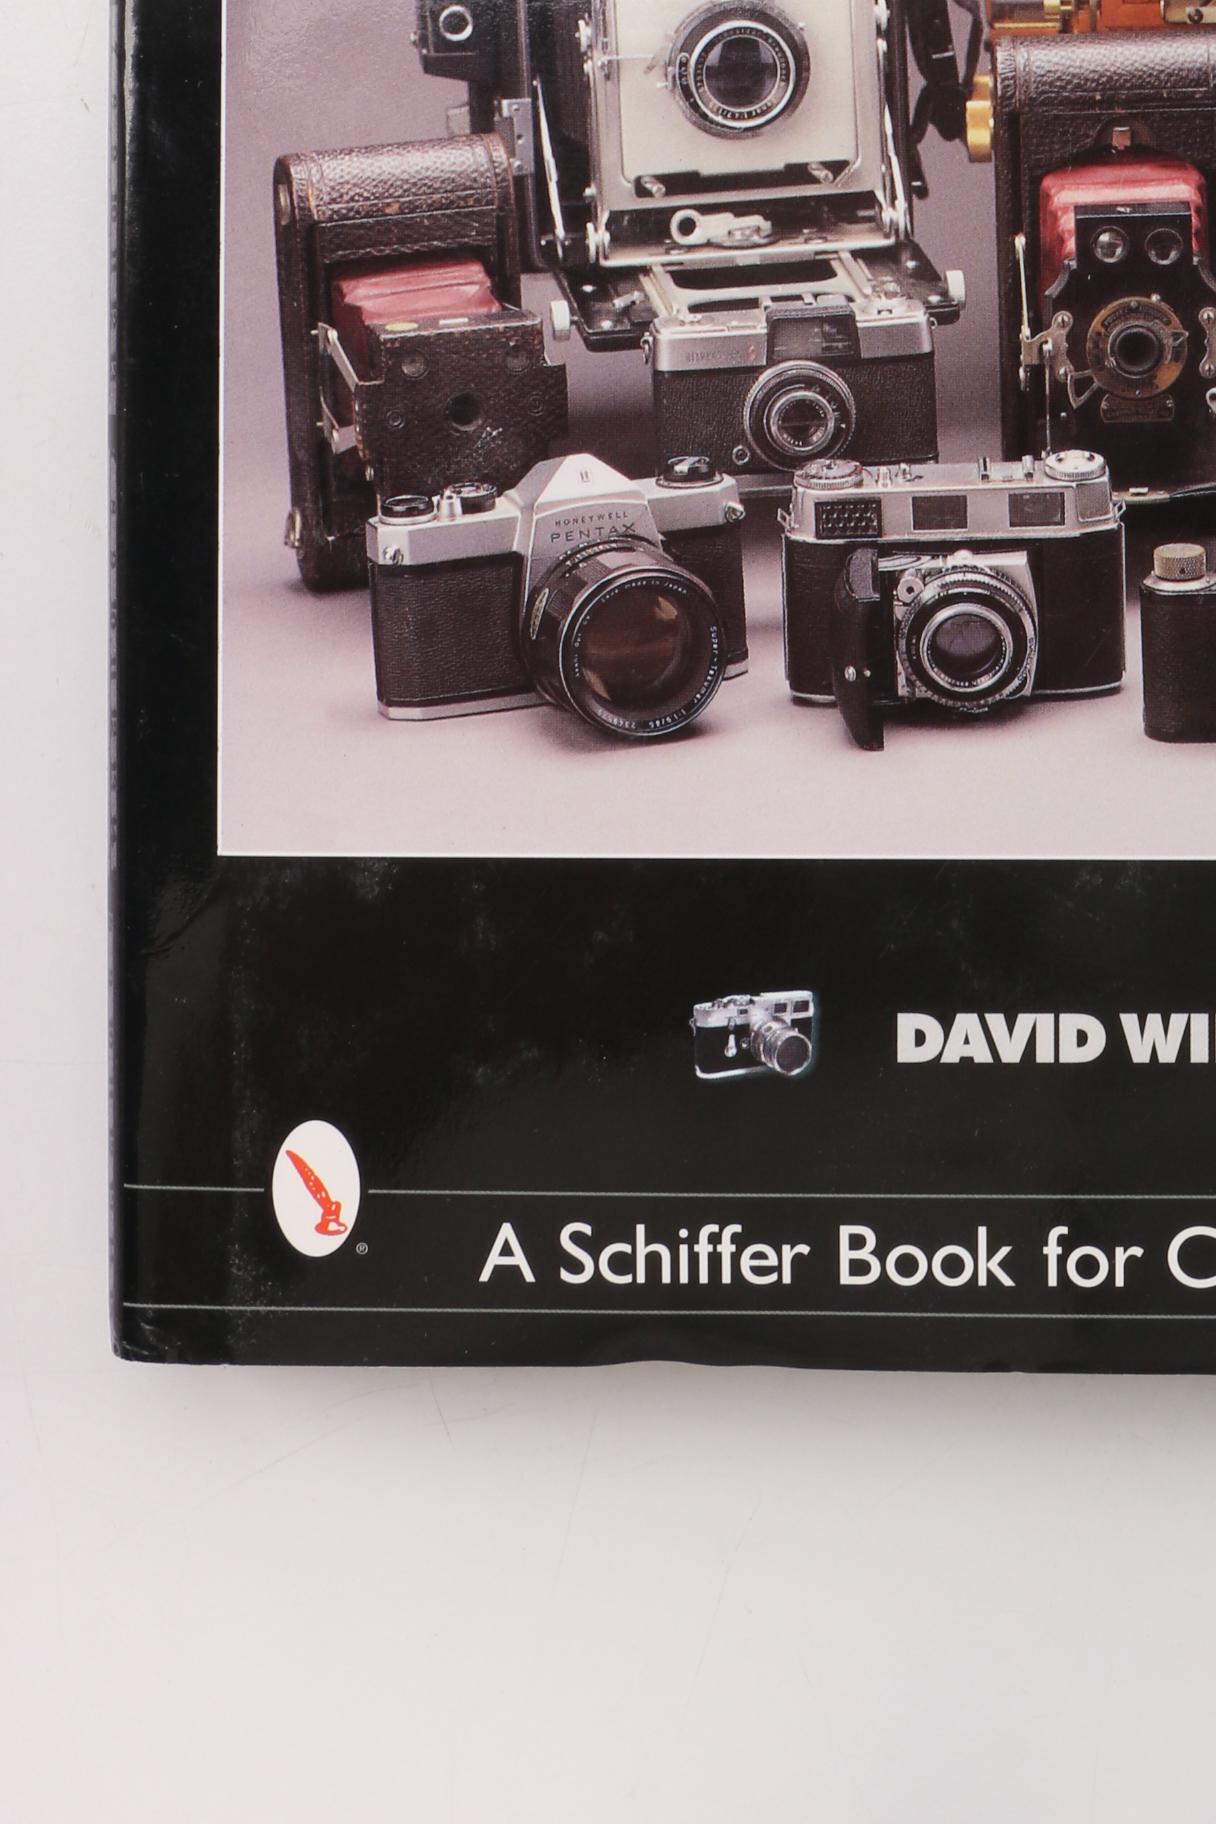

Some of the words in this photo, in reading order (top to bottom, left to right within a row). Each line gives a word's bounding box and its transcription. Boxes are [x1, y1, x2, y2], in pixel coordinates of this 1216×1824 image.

[550, 522, 637, 544] PENTAX
[555, 511, 629, 527] HONEYWELL
[897, 1013, 1106, 1064] DAVID
[479, 1223, 535, 1283] A
[559, 1221, 811, 1285] Schiffer
[839, 1224, 1016, 1287] Book
[1042, 1225, 1145, 1288] for
